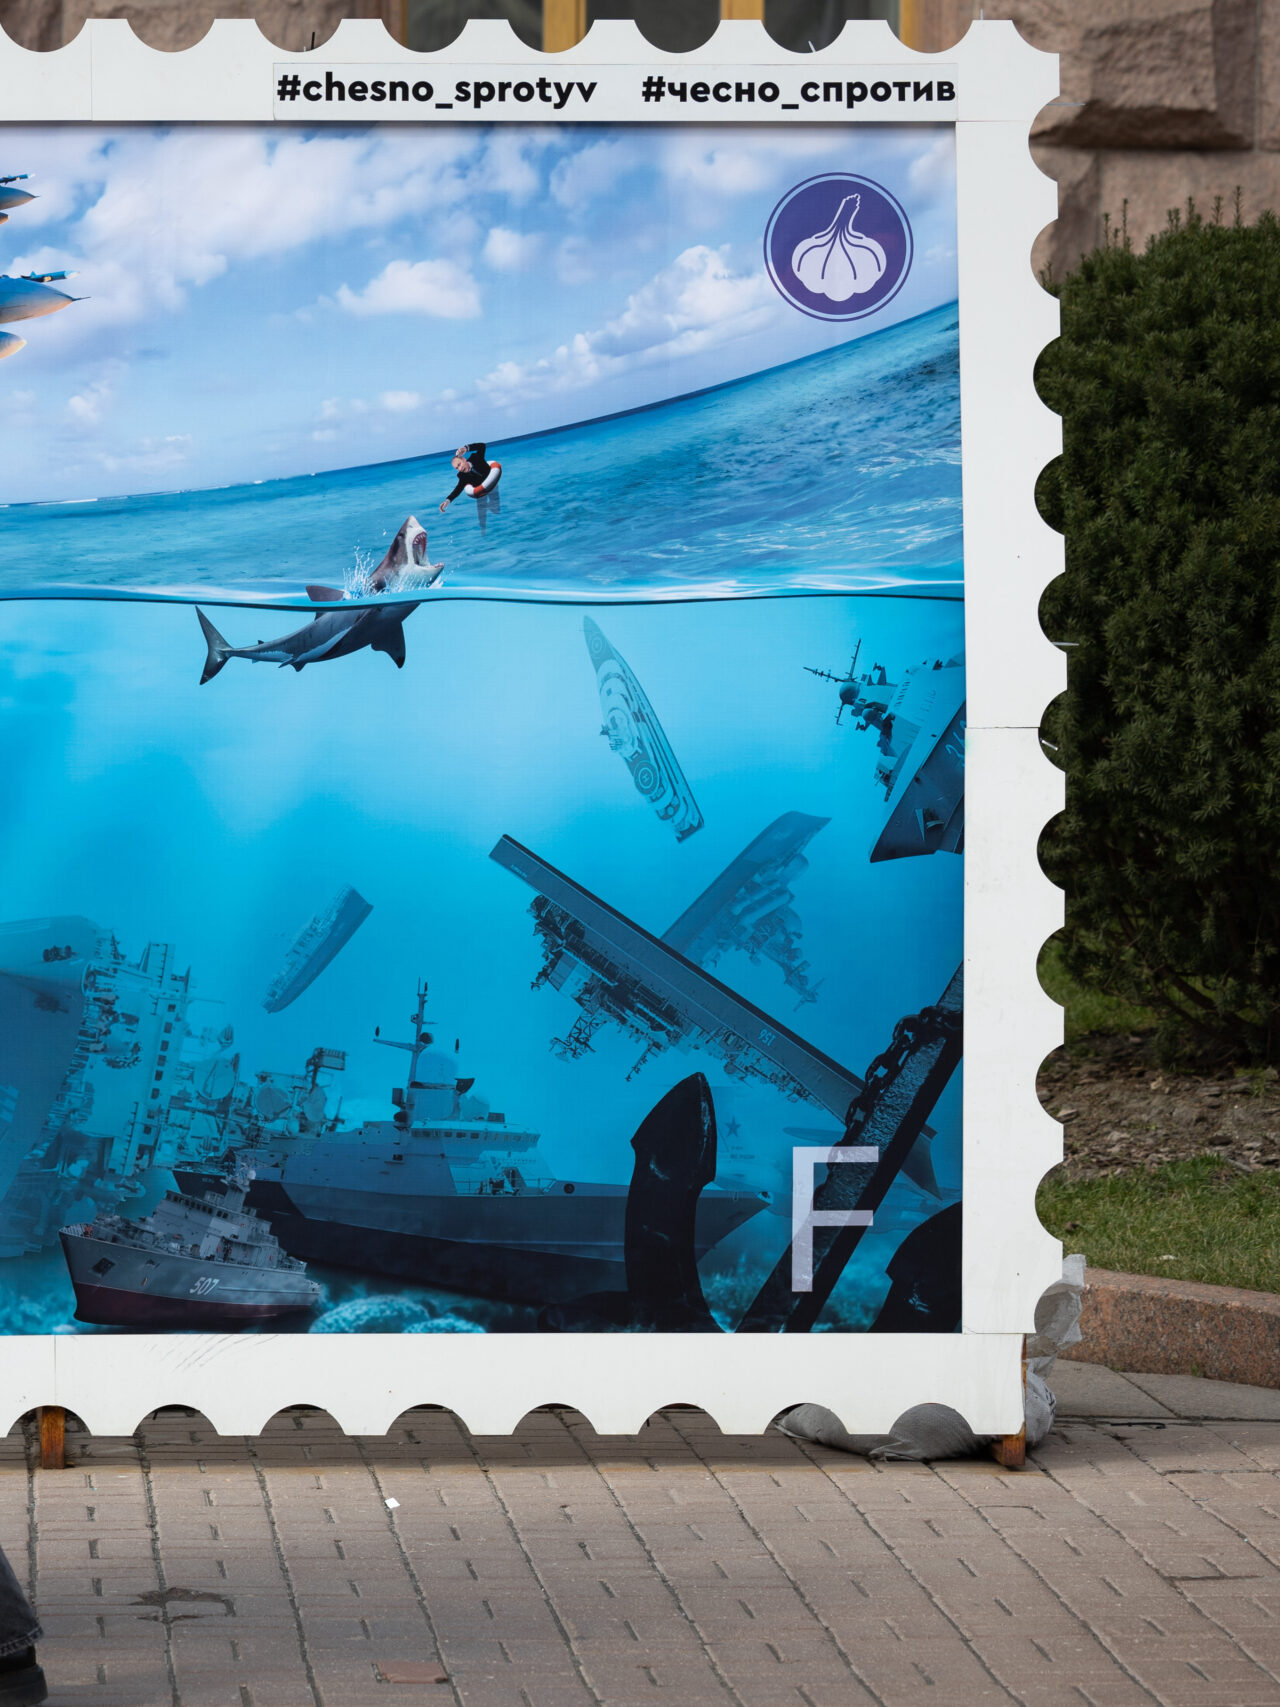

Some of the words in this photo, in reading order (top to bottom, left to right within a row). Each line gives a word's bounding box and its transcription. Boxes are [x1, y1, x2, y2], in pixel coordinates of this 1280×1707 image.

[276, 71, 598, 110] #chesno_sprotyv
[641, 75, 956, 110] #чесно_спротив
[791, 1146, 879, 1292] F
[189, 1276, 220, 1296] 507
